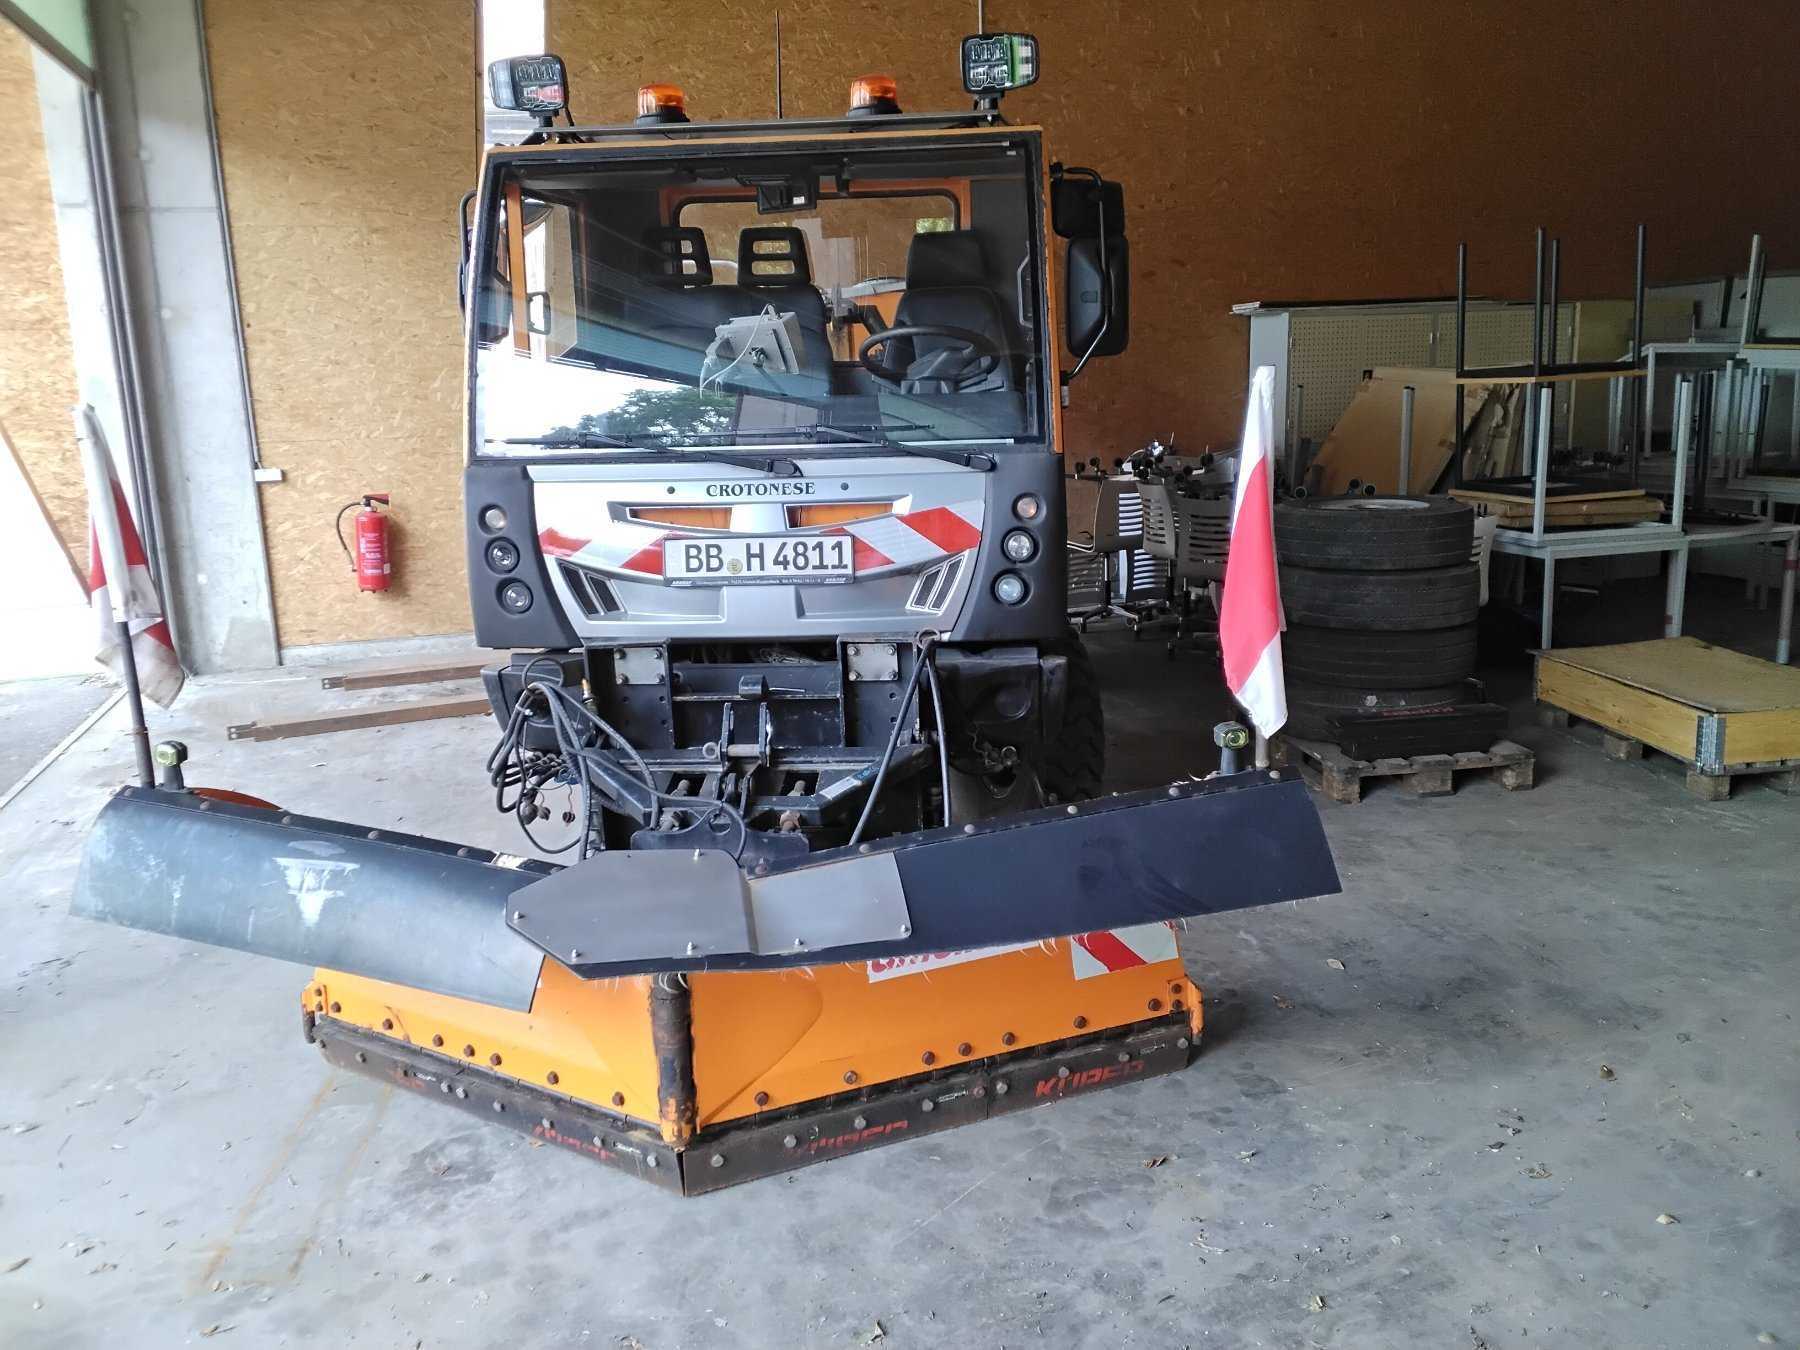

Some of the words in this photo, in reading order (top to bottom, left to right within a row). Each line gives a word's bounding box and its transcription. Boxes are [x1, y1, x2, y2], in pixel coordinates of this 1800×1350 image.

[706, 482, 816, 497] CROTONESE
[684, 543, 724, 573] BB
[745, 542, 765, 572] H
[772, 540, 848, 571] 4811
